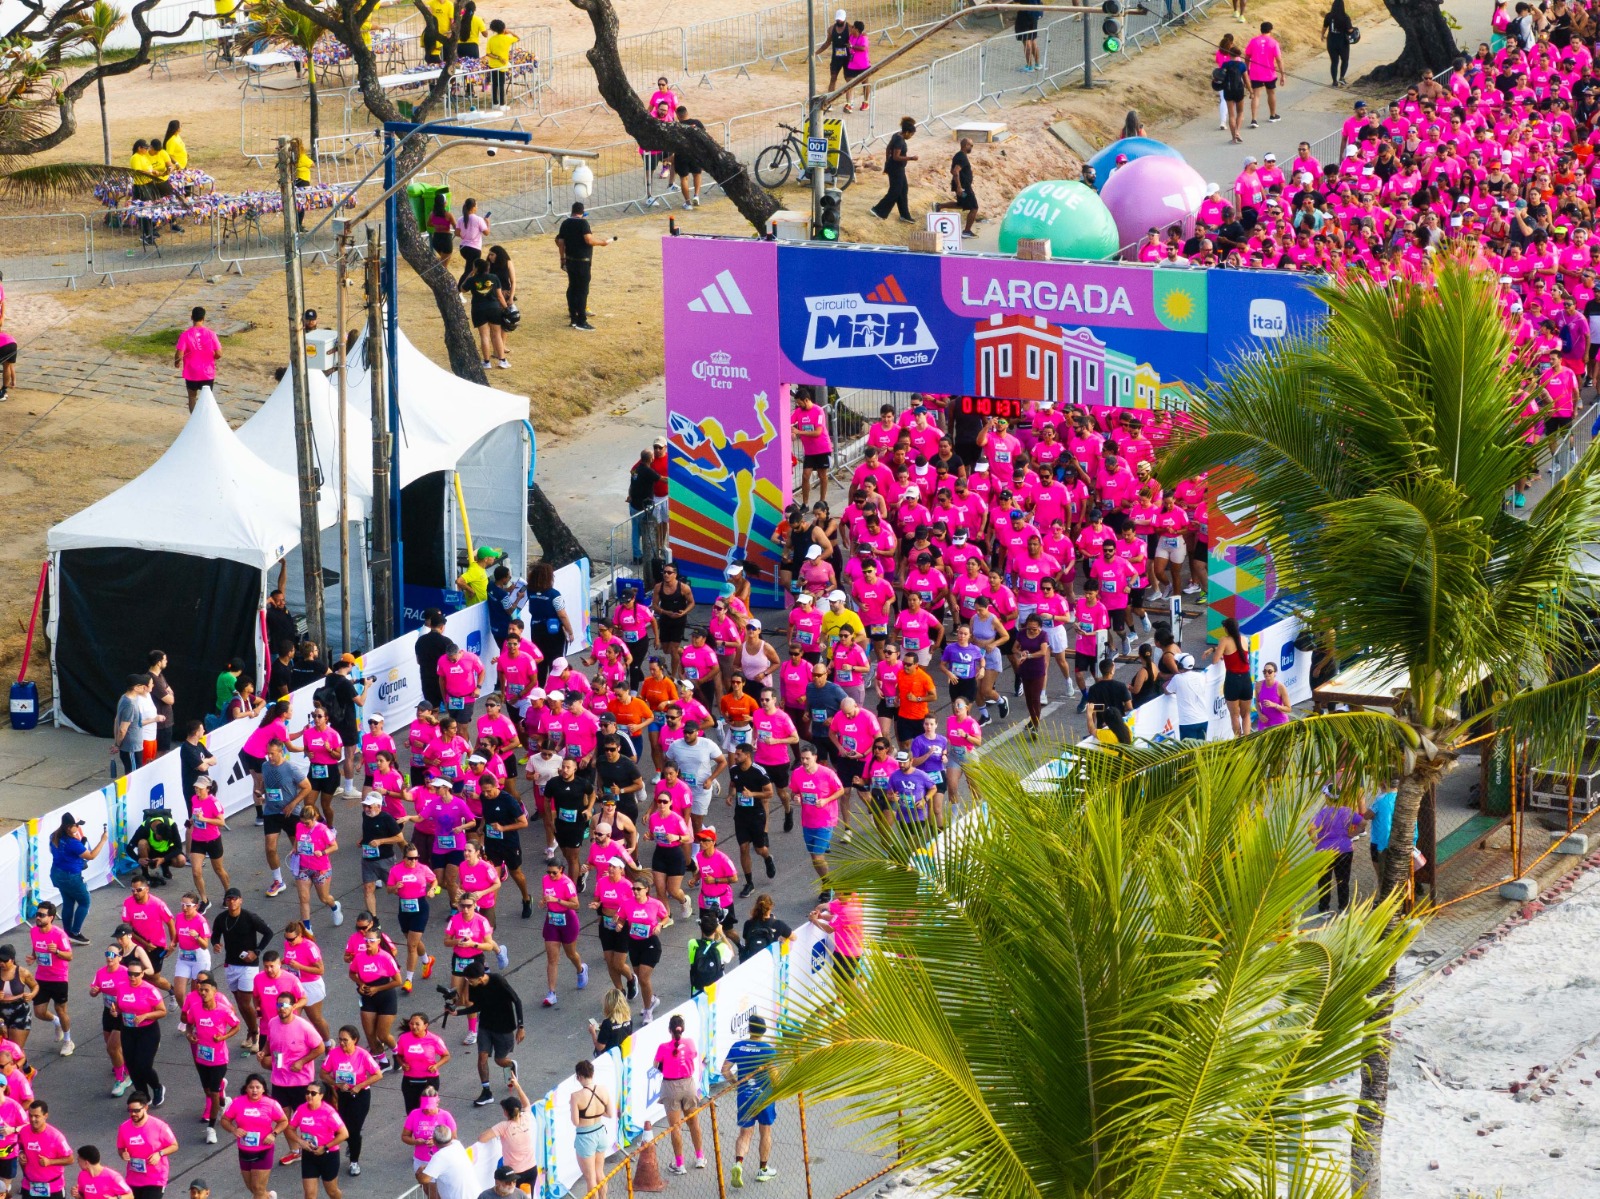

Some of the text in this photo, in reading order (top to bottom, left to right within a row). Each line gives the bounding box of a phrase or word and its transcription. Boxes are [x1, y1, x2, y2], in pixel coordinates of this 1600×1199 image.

[809, 142, 826, 152] 001
[1039, 183, 1083, 211] QUE
[1012, 197, 1061, 226] SUA!
[940, 222, 948, 234] E
[961, 276, 1134, 316] LARGADA
[815, 299, 858, 311] circuito
[1253, 314, 1283, 330] itaú
[894, 353, 929, 365] Recife
[691, 360, 749, 381] Corona
[711, 377, 732, 389] Cero
[378, 677, 407, 701] Corona
